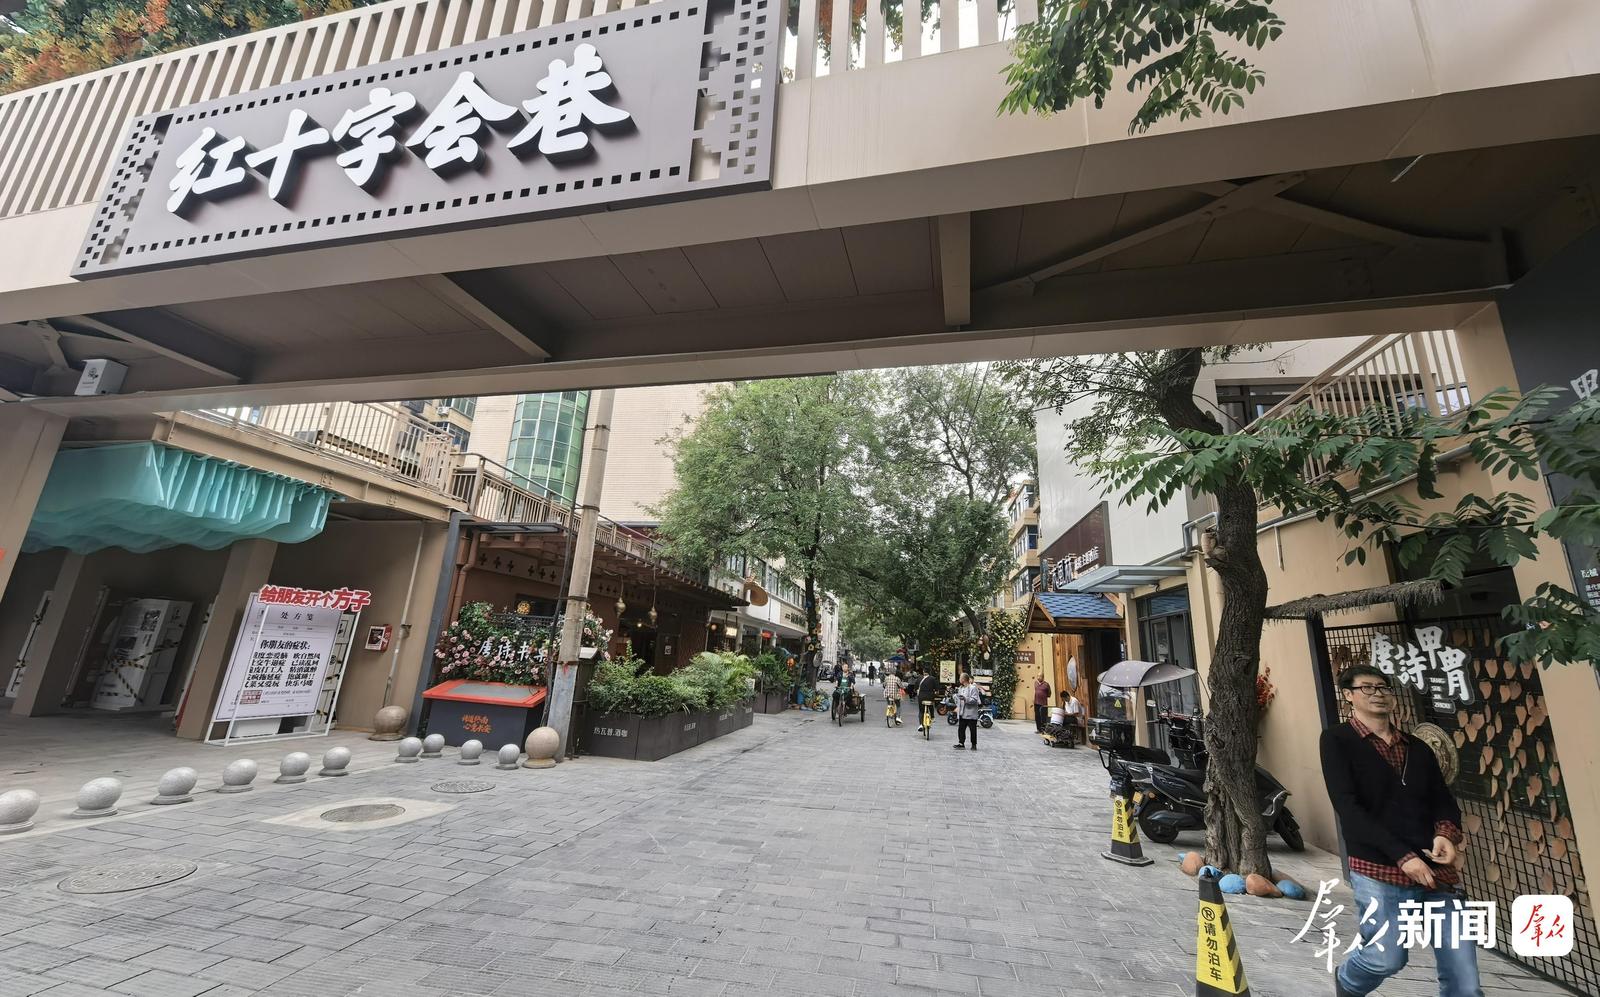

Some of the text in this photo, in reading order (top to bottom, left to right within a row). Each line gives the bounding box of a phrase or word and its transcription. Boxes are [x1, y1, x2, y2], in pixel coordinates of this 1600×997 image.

[166, 43, 631, 216] 红十字会巷
[259, 586, 371, 611] 给朋友开个方子
[1204, 921, 1223, 982] 请勿泊车
